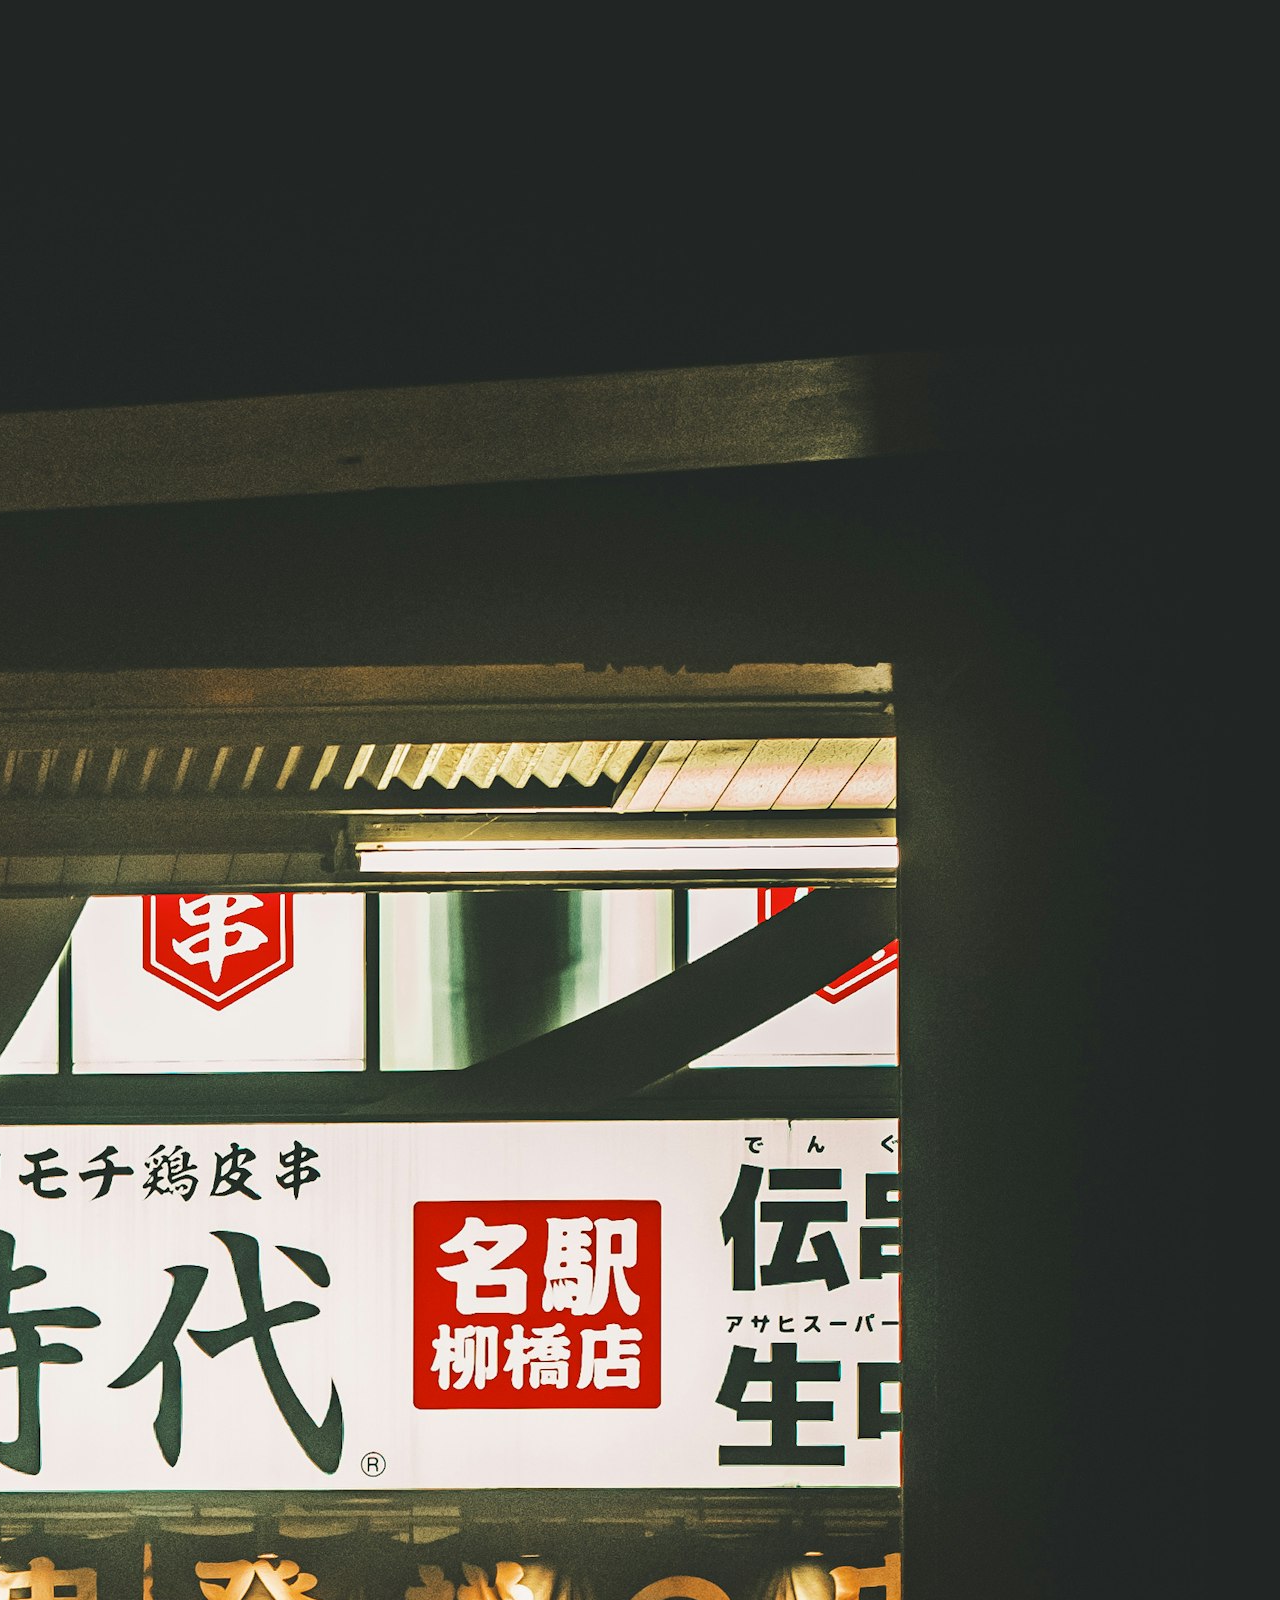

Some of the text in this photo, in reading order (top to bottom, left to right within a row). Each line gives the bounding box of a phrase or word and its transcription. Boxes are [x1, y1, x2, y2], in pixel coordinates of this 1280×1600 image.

[436, 1216, 641, 1316] 名駅
[430, 1324, 642, 1391] 柳橋店
